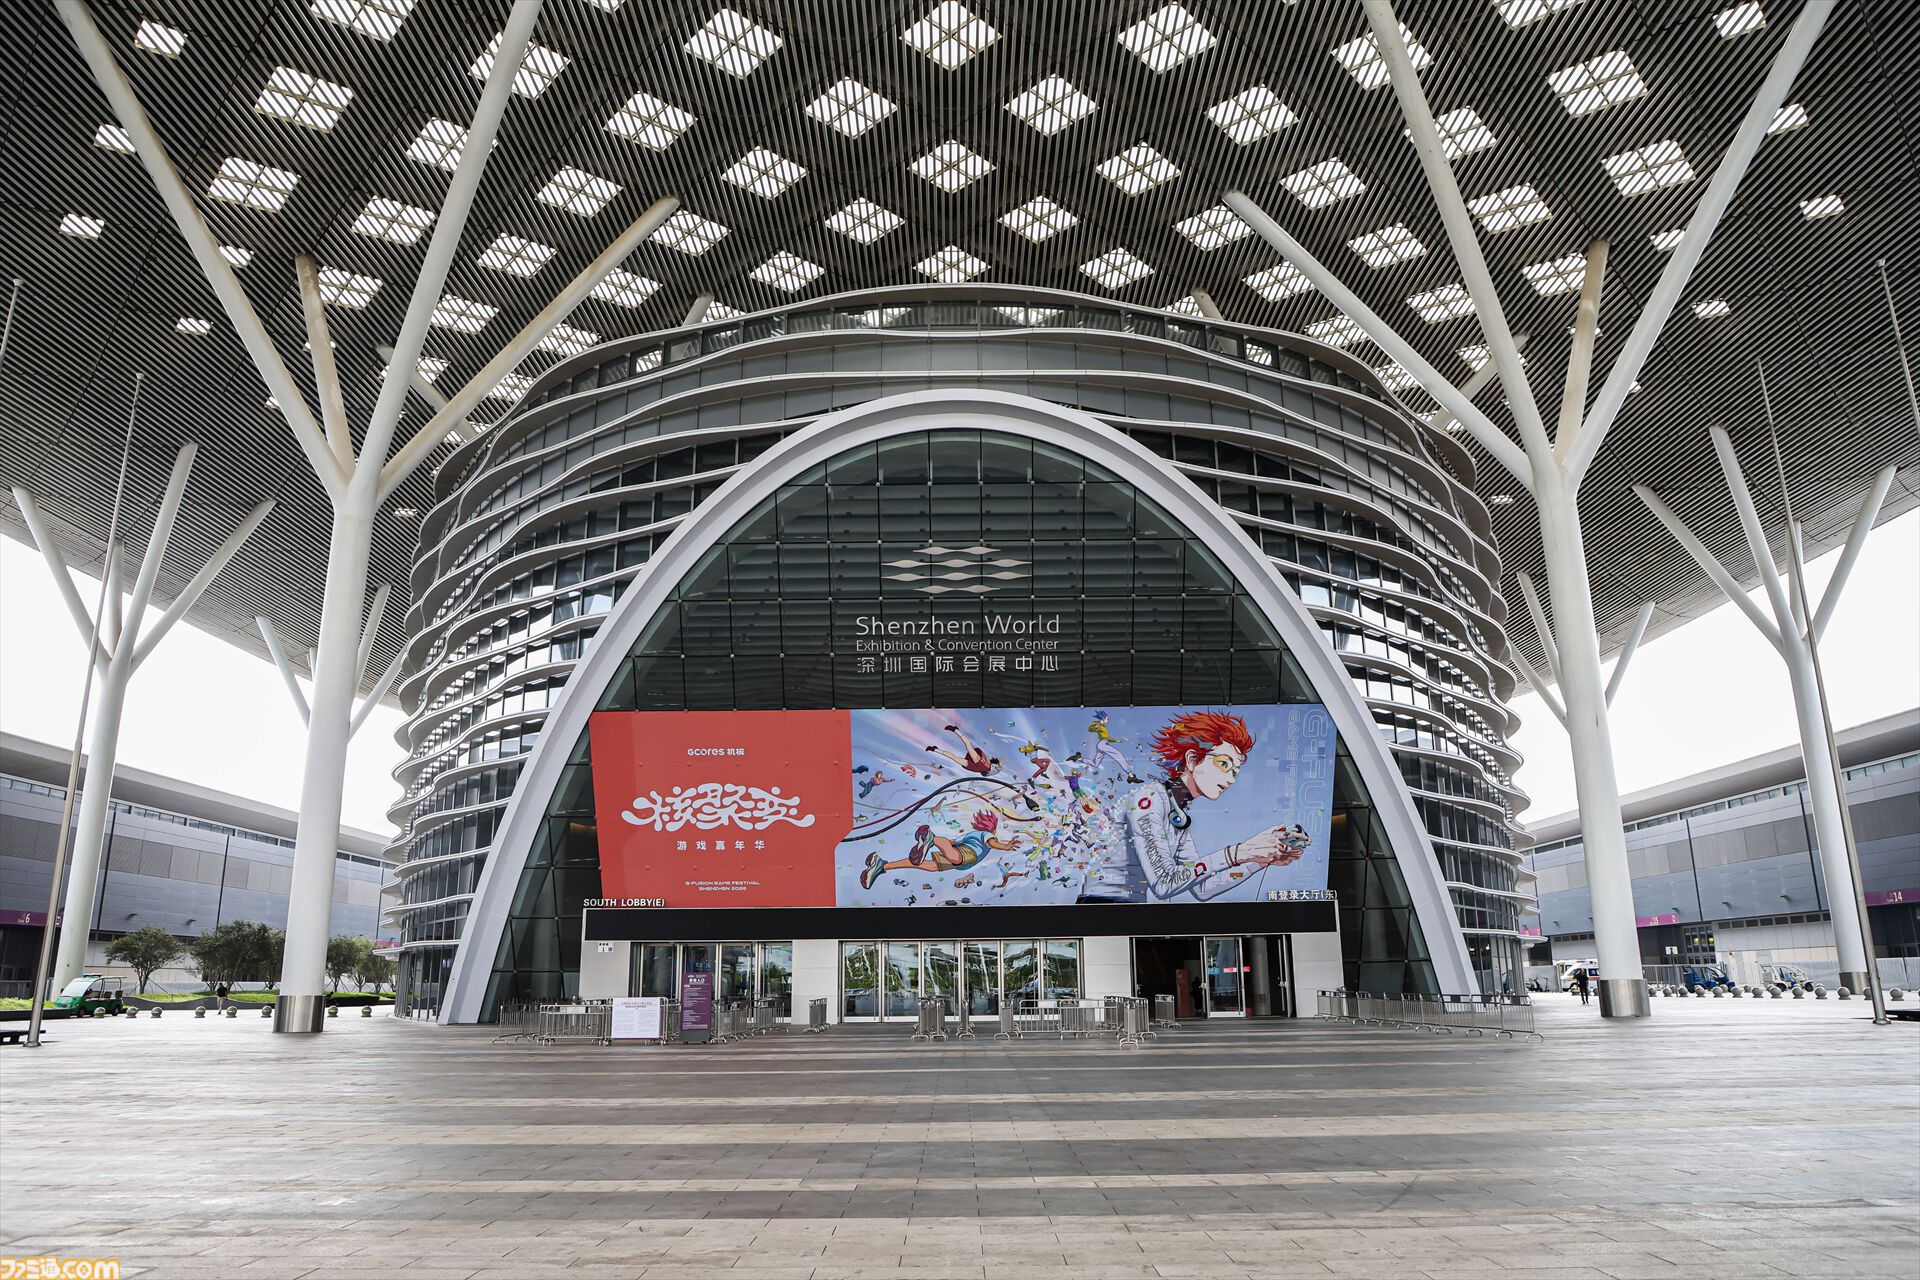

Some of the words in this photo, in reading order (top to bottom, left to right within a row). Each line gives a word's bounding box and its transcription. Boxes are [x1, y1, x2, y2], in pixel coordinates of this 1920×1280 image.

[856, 615, 975, 635] Shenzhen
[984, 614, 1060, 634] World
[856, 640, 920, 652] Exhibition
[924, 638, 935, 651] &
[938, 638, 1012, 651] Convention
[1015, 637, 1059, 650] Center
[857, 655, 1059, 673] 深圳国际会展中心
[676, 840, 765, 851] 游戏嘉年华
[1268, 889, 1338, 900] 南登录大厅(东)
[1893, 891, 1903, 902] 14
[583, 898, 617, 907] SOUTH
[621, 898, 665, 907] LOBBY(E)
[25, 913, 31, 924] 6
